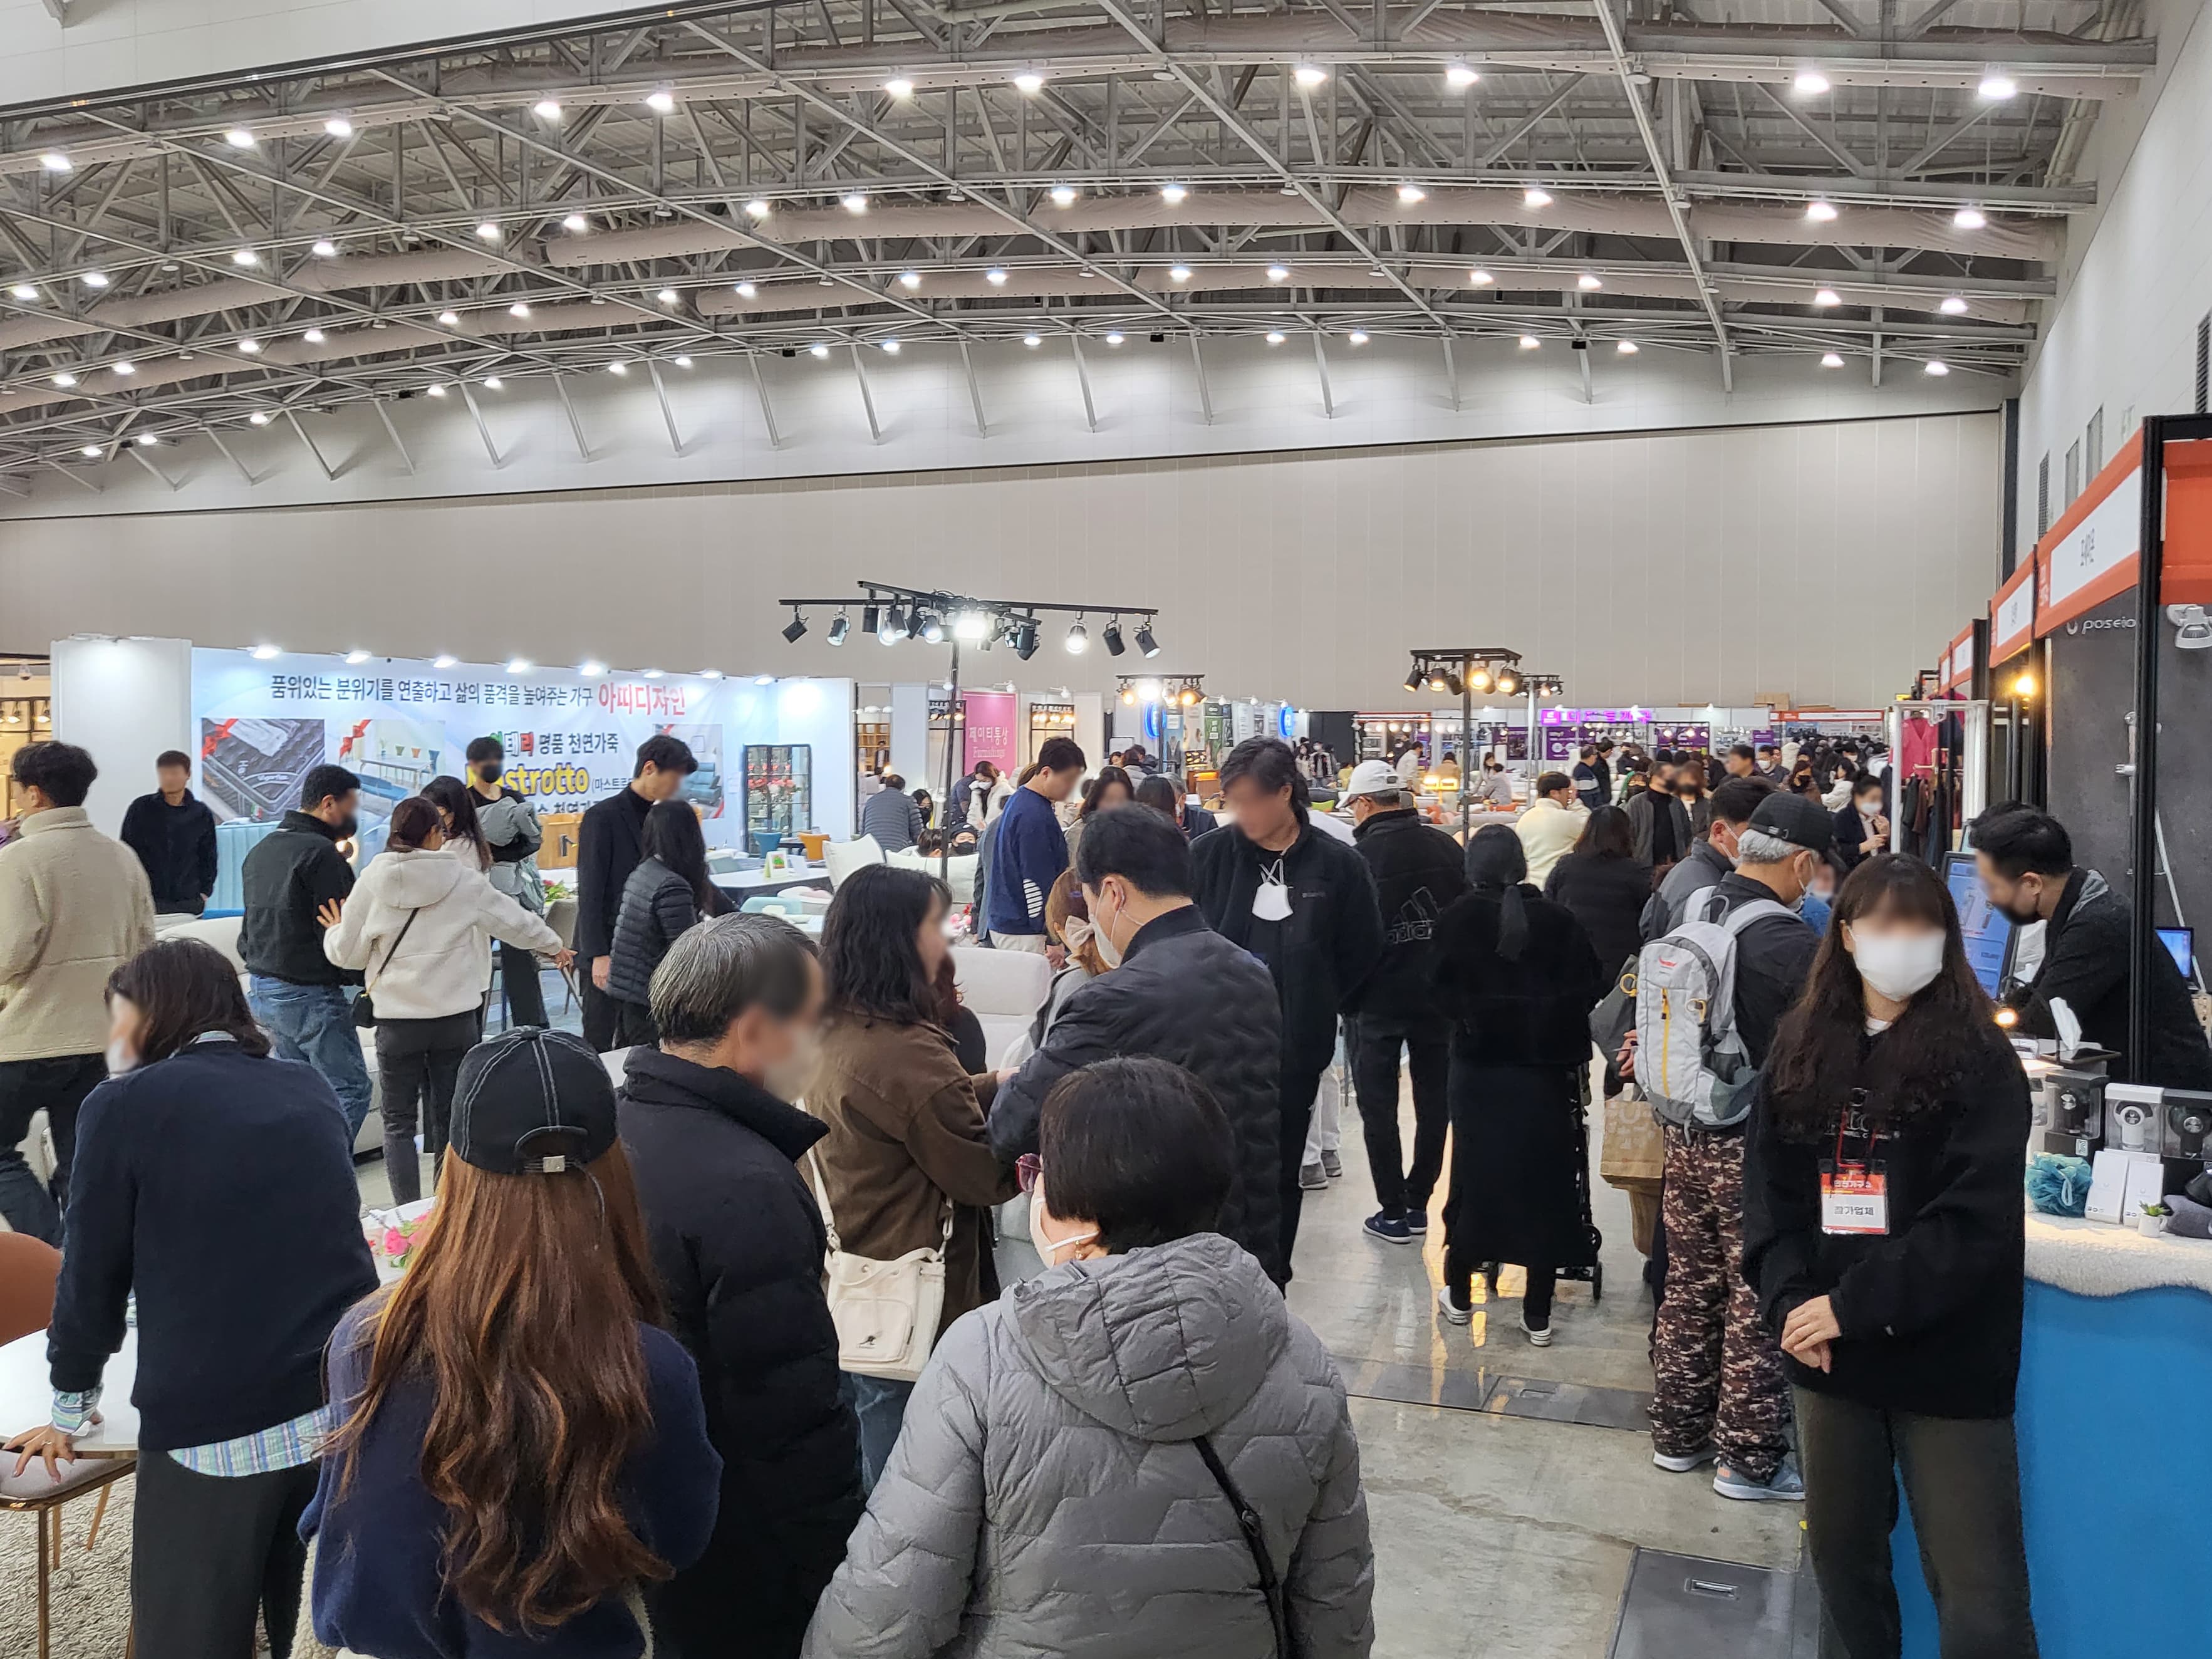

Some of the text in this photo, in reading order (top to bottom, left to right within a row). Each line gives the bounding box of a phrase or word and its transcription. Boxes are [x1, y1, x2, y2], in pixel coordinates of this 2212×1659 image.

[271, 675, 685, 716] 품위있는 분위기를 연출하고 삶의 품격을 높여주는 가구 아띠디자인
[539, 732, 563, 754] 명품
[568, 732, 618, 754] 천연가죽
[465, 761, 589, 796] strotto
